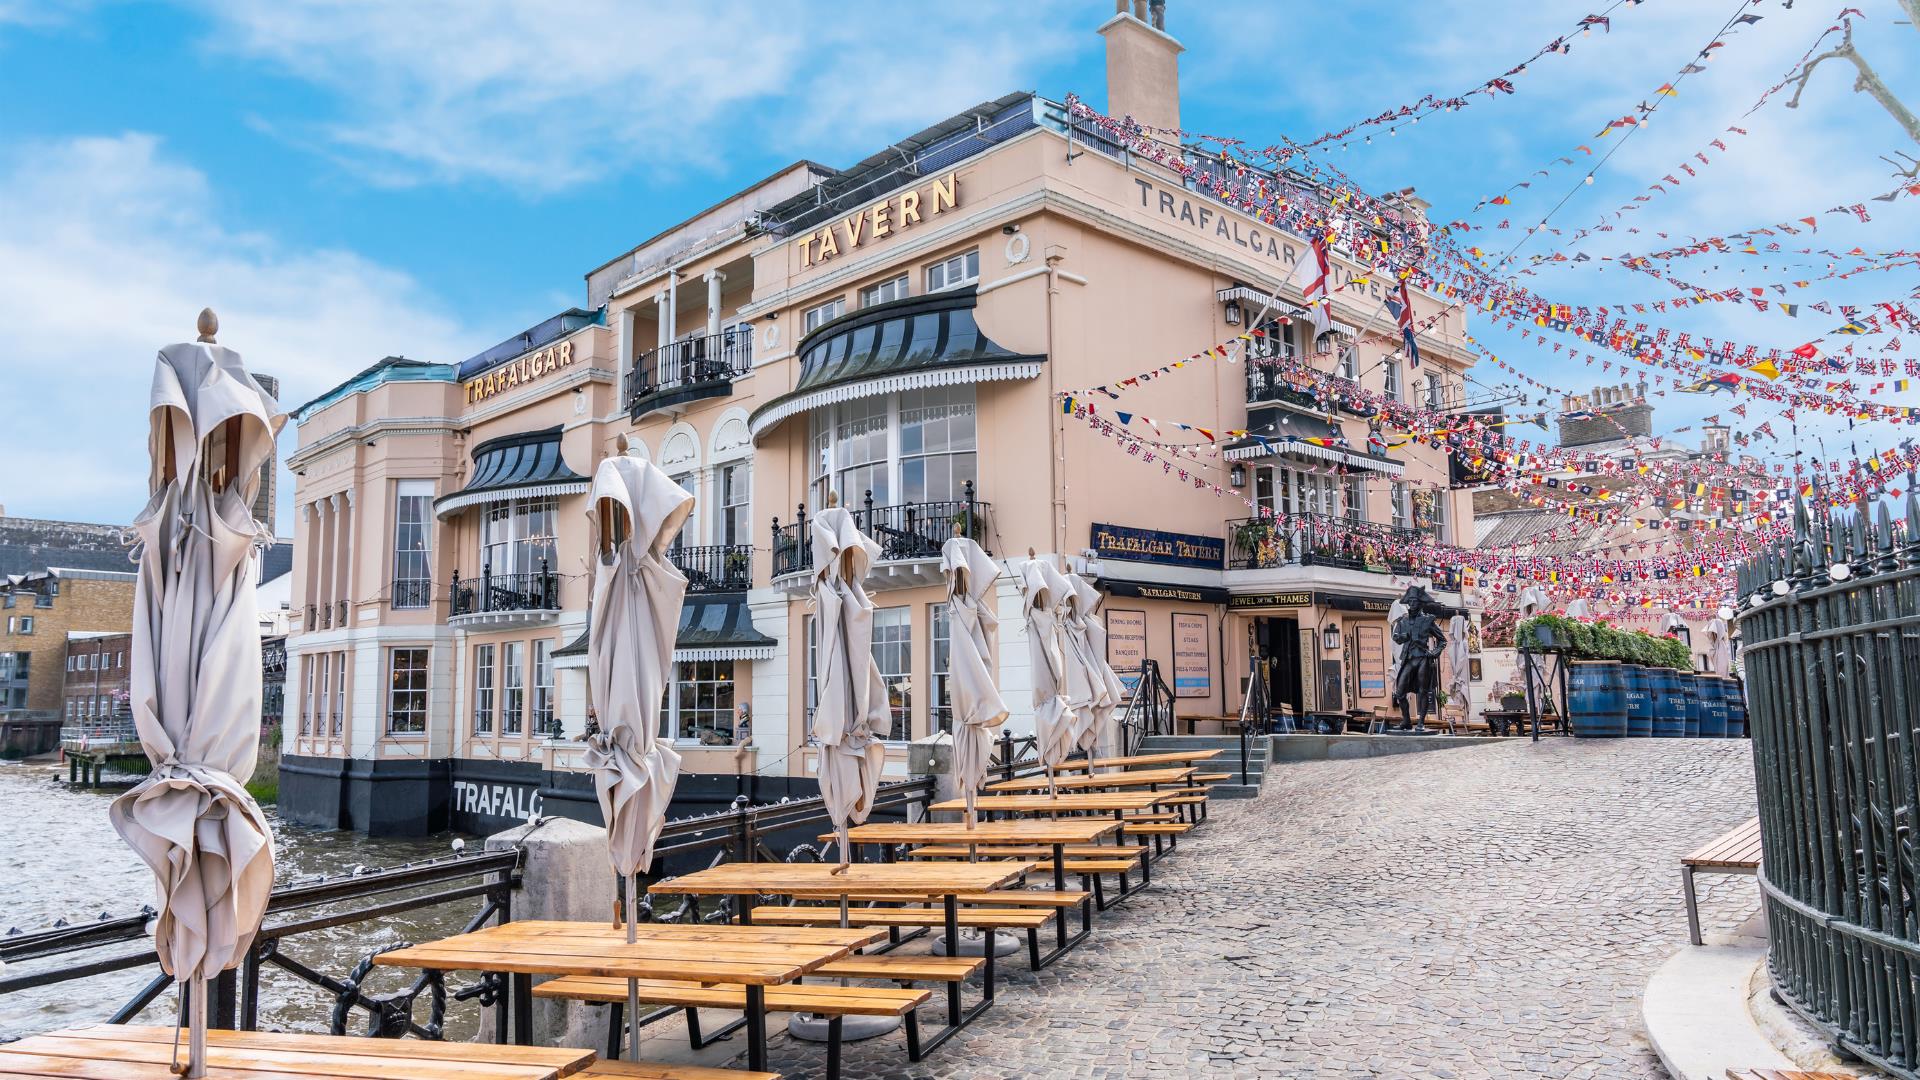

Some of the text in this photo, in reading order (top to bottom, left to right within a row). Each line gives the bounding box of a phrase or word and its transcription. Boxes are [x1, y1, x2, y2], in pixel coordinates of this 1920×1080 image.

[798, 172, 958, 268] TAVERN
[1134, 177, 1296, 267] TRAFALGAR
[463, 340, 574, 405] TRAFALGAR
[1097, 531, 1221, 560] TRAFALGAR TAVERN
[1137, 586, 1202, 601] TRAFALGAR TAVERN
[1231, 597, 1256, 606] JEWEL
[1274, 594, 1310, 604] THAMES
